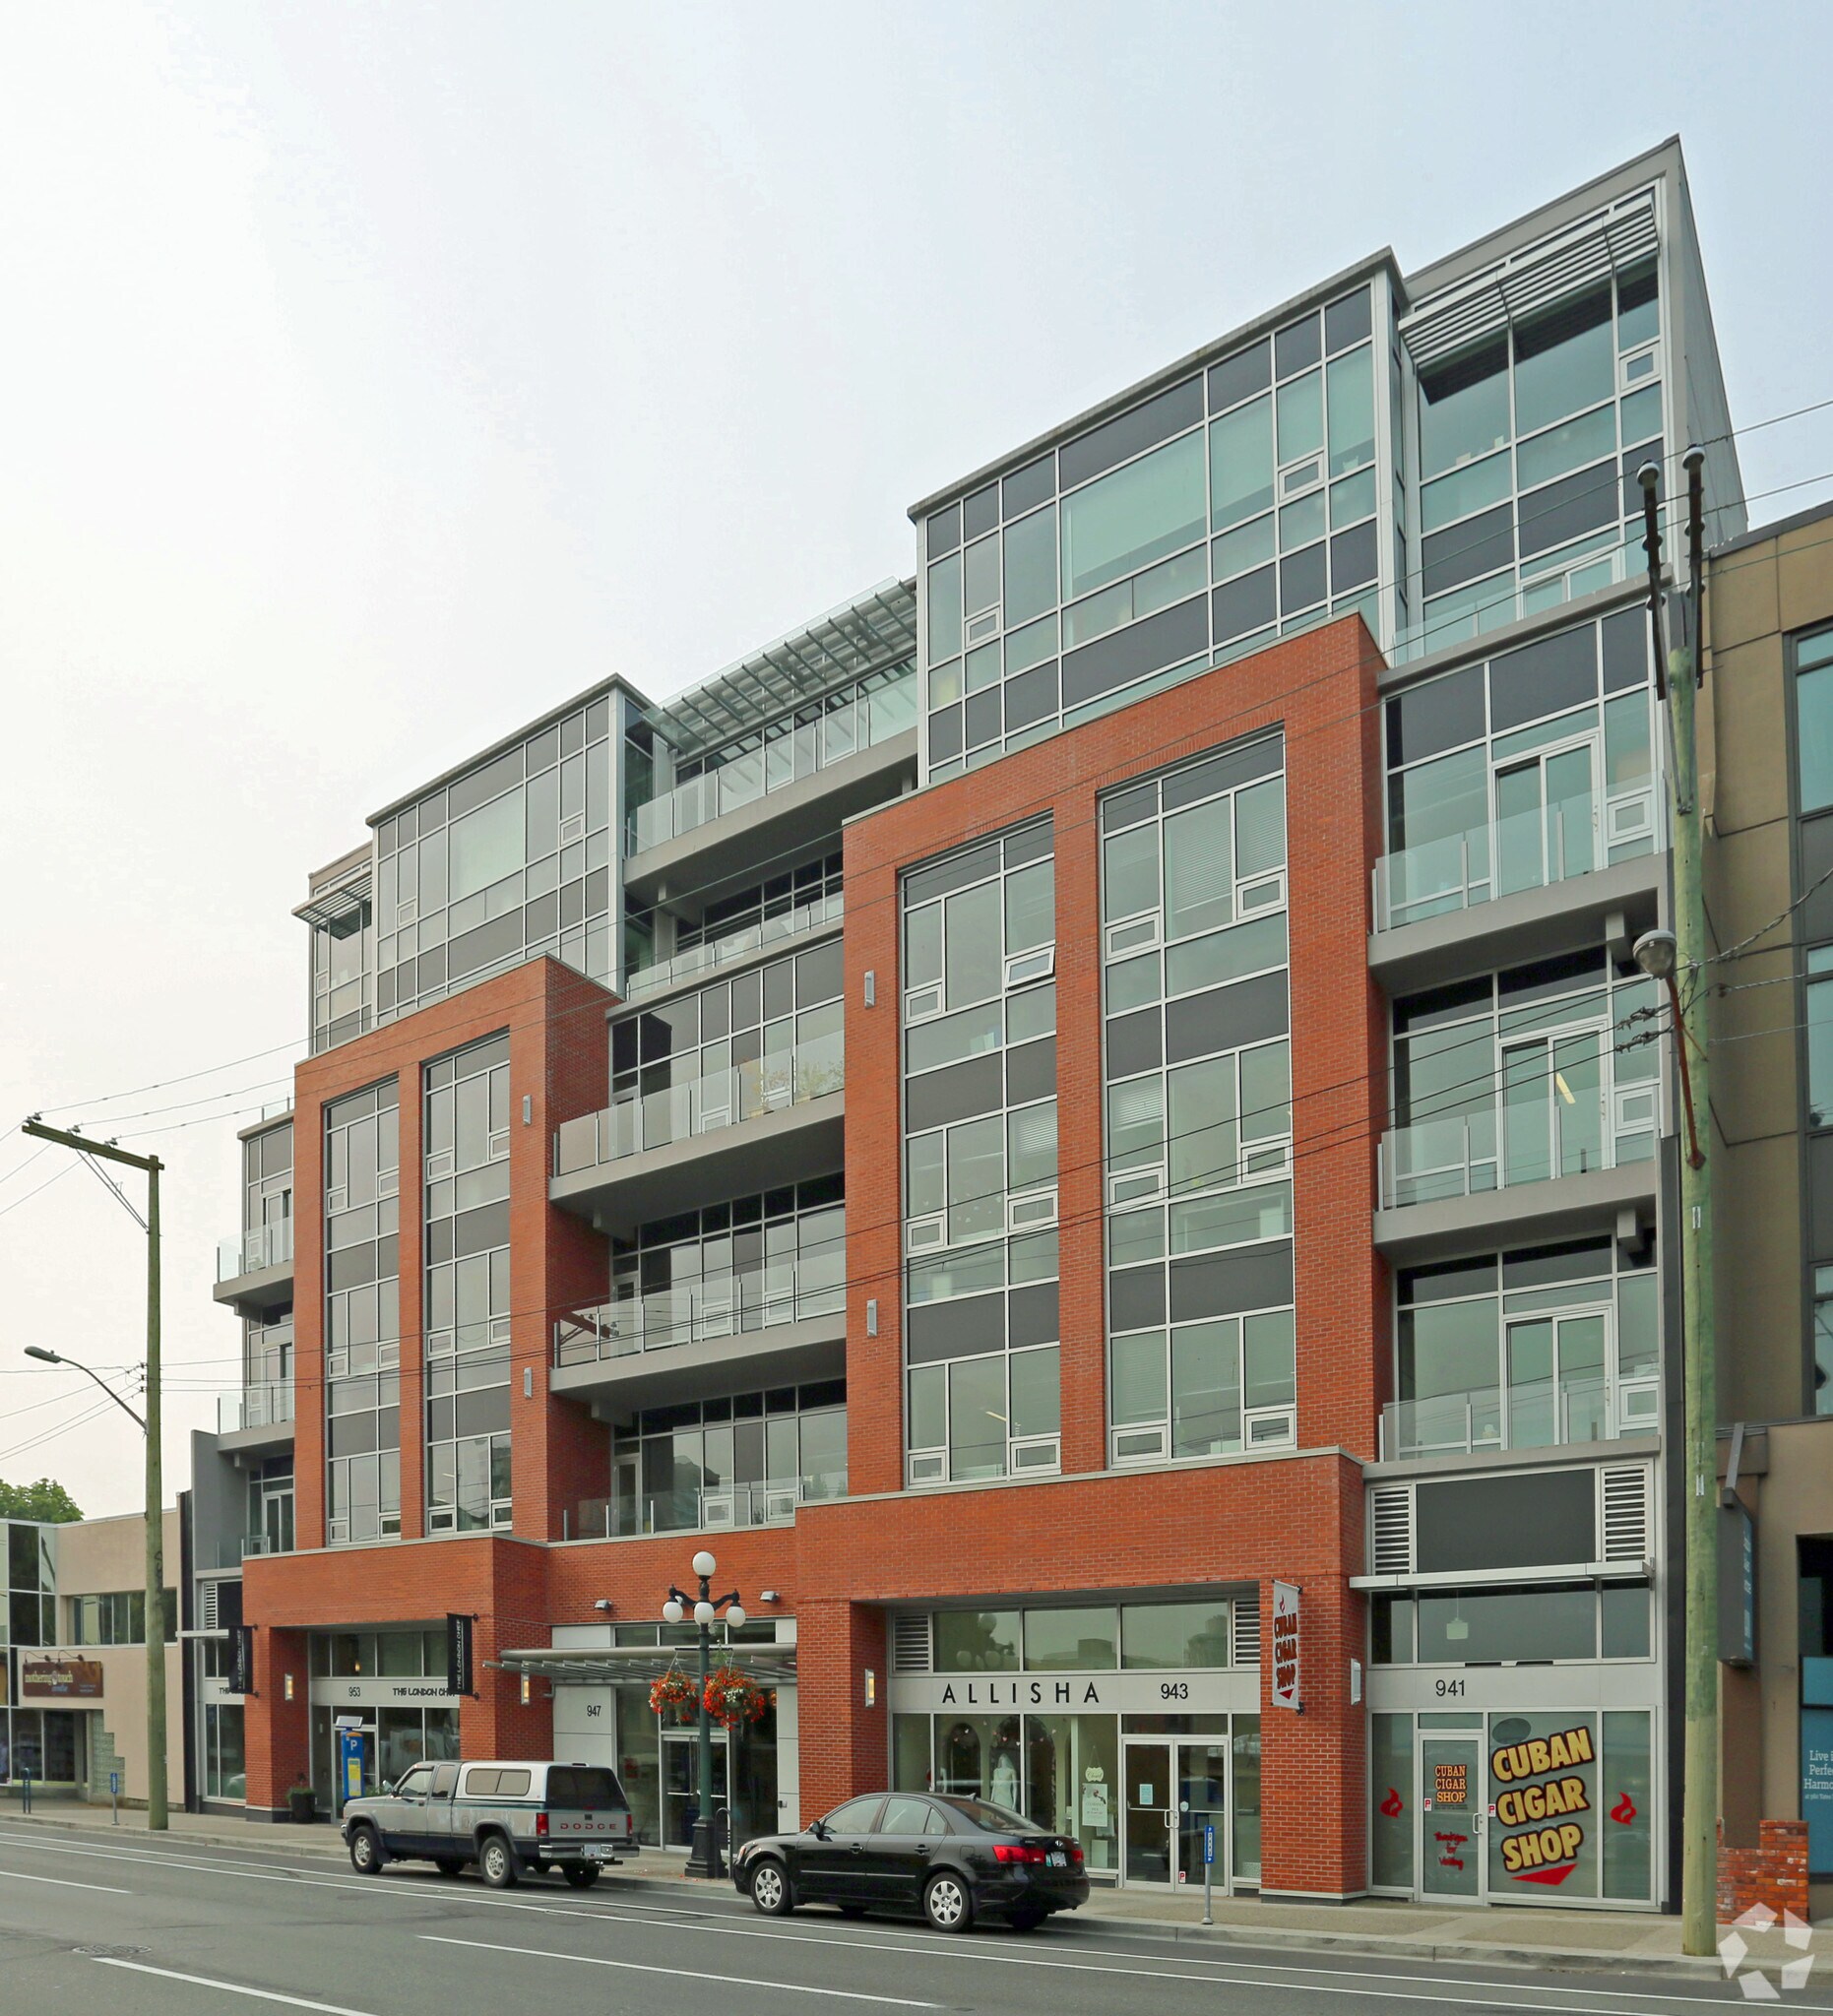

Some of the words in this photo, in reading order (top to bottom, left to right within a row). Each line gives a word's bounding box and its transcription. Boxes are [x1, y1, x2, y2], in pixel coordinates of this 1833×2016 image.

[1275, 1612, 1297, 1639] CUBAN
[1275, 1638, 1297, 1665] CIGAR
[1276, 1664, 1296, 1689] SHOP
[348, 1686, 361, 1698] 953
[393, 1687, 407, 1697] THE
[408, 1687, 437, 1697] LONDON
[942, 1681, 1100, 1704] ALLISHA
[1161, 1683, 1188, 1700] 943
[1435, 1679, 1465, 1697] 941
[587, 1705, 601, 1717] 947
[350, 1739, 358, 1751] P
[1491, 1726, 1595, 1783] CUBAN
[1809, 1749, 1829, 1762] Live
[1434, 1764, 1467, 1777] CUBAN
[1434, 1778, 1467, 1791] CIGAR
[1435, 1791, 1467, 1803] SHOP
[1496, 1776, 1591, 1827] CIGAR
[1501, 1822, 1584, 1872] SHOP
